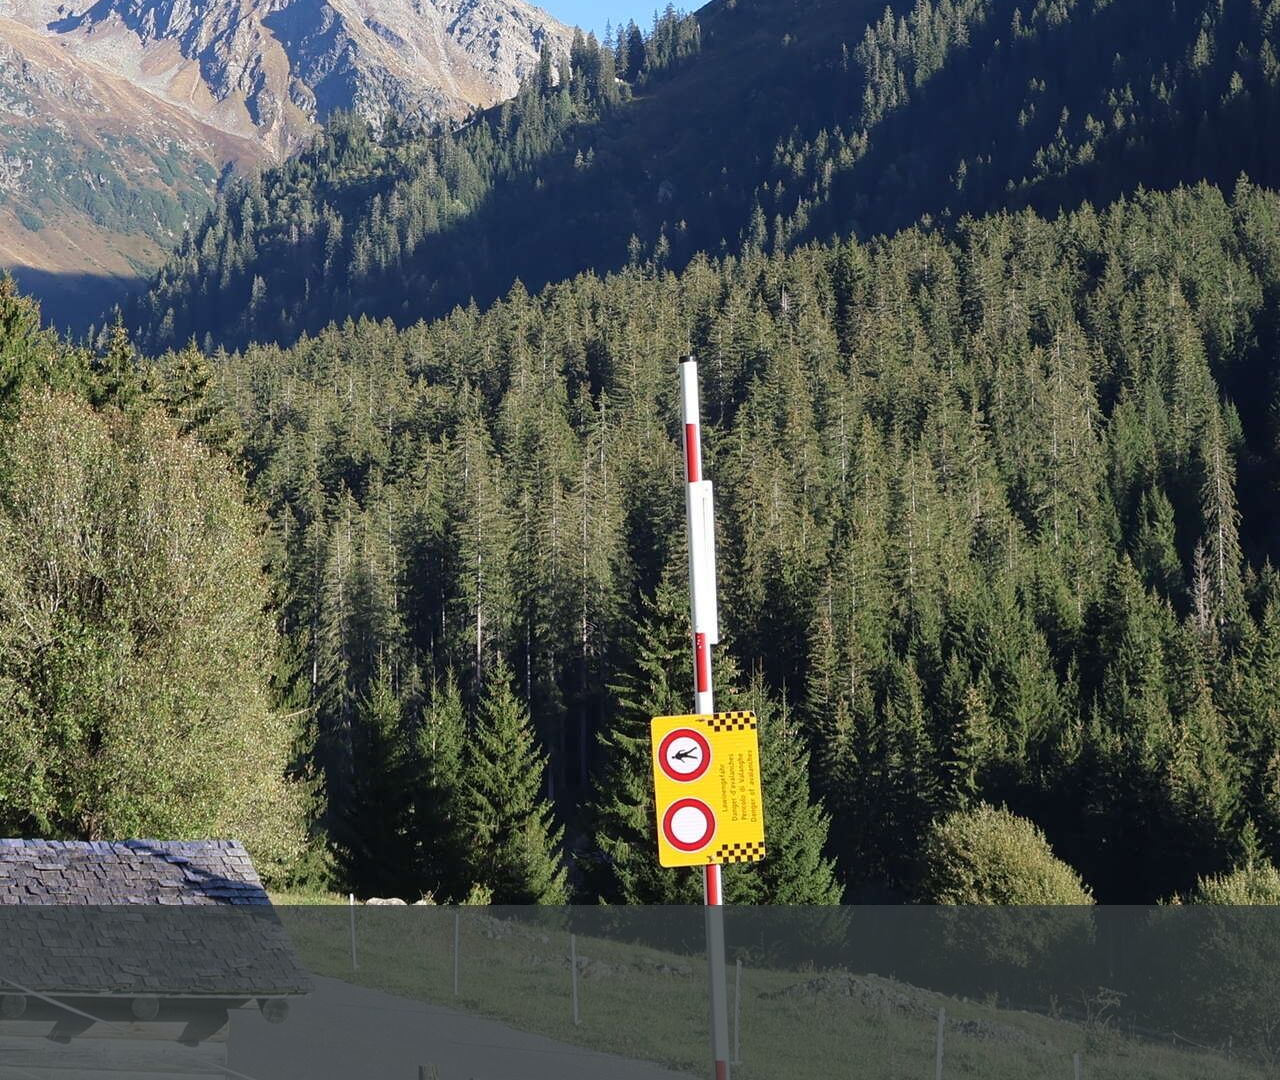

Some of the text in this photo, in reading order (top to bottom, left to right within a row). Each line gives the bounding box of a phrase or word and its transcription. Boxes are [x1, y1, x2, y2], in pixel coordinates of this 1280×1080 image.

[747, 750, 755, 785] avalanches
[719, 764, 728, 812] Lawinengefahr
[731, 798, 739, 821] Danger
